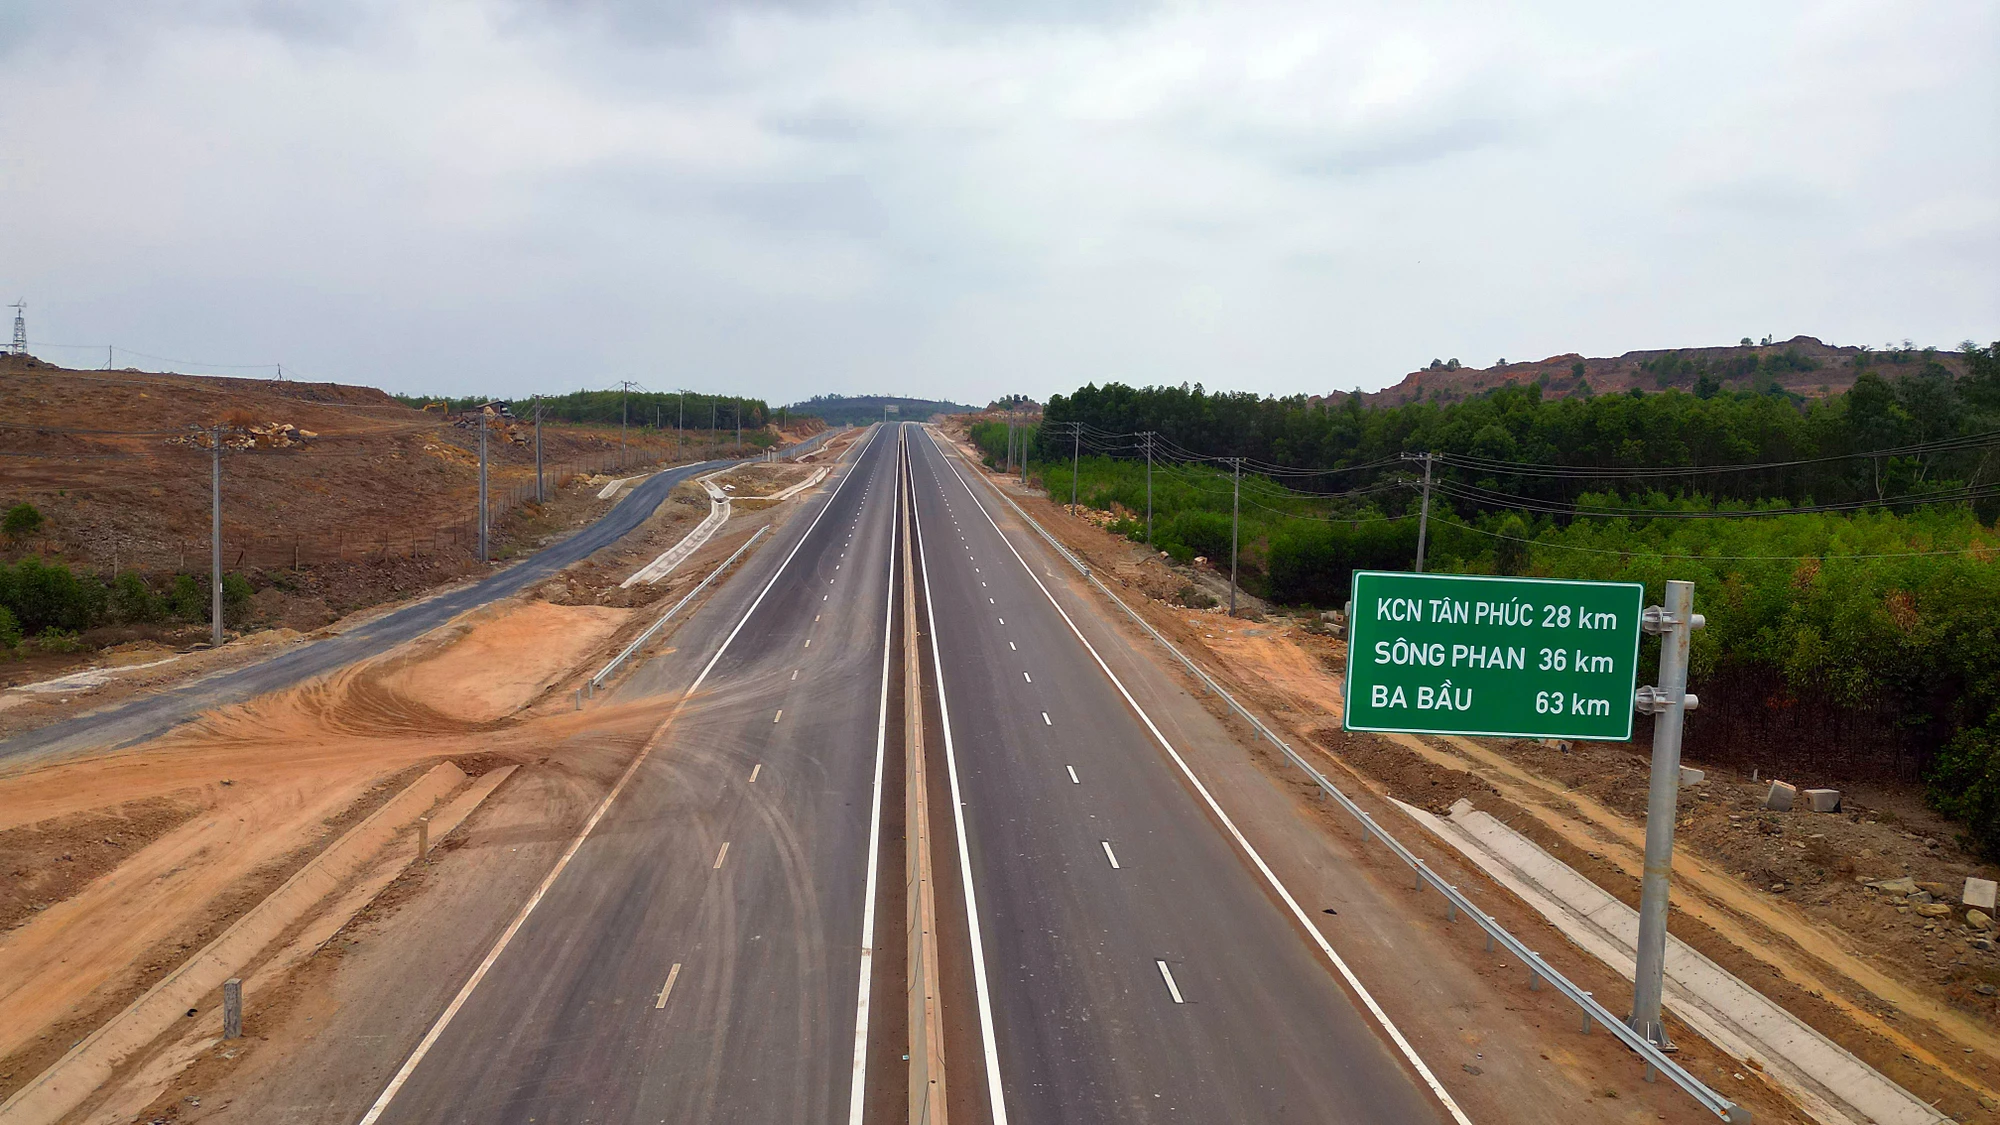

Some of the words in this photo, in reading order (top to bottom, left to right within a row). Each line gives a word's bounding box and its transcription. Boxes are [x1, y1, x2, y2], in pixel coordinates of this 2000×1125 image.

[1376, 597, 1423, 622] KCN
[1428, 596, 1469, 625] TÂN
[1474, 596, 1534, 627] PHÚC
[1541, 604, 1571, 629] 28
[1578, 606, 1617, 630] km
[1374, 637, 1445, 667] SÔNG
[1451, 644, 1526, 670] PHAN
[1538, 648, 1567, 672] 36
[1575, 649, 1614, 673] km
[1371, 684, 1408, 709] BA
[1417, 679, 1472, 711] BẦU
[1535, 691, 1564, 714] 63
[1571, 692, 1610, 716] km
